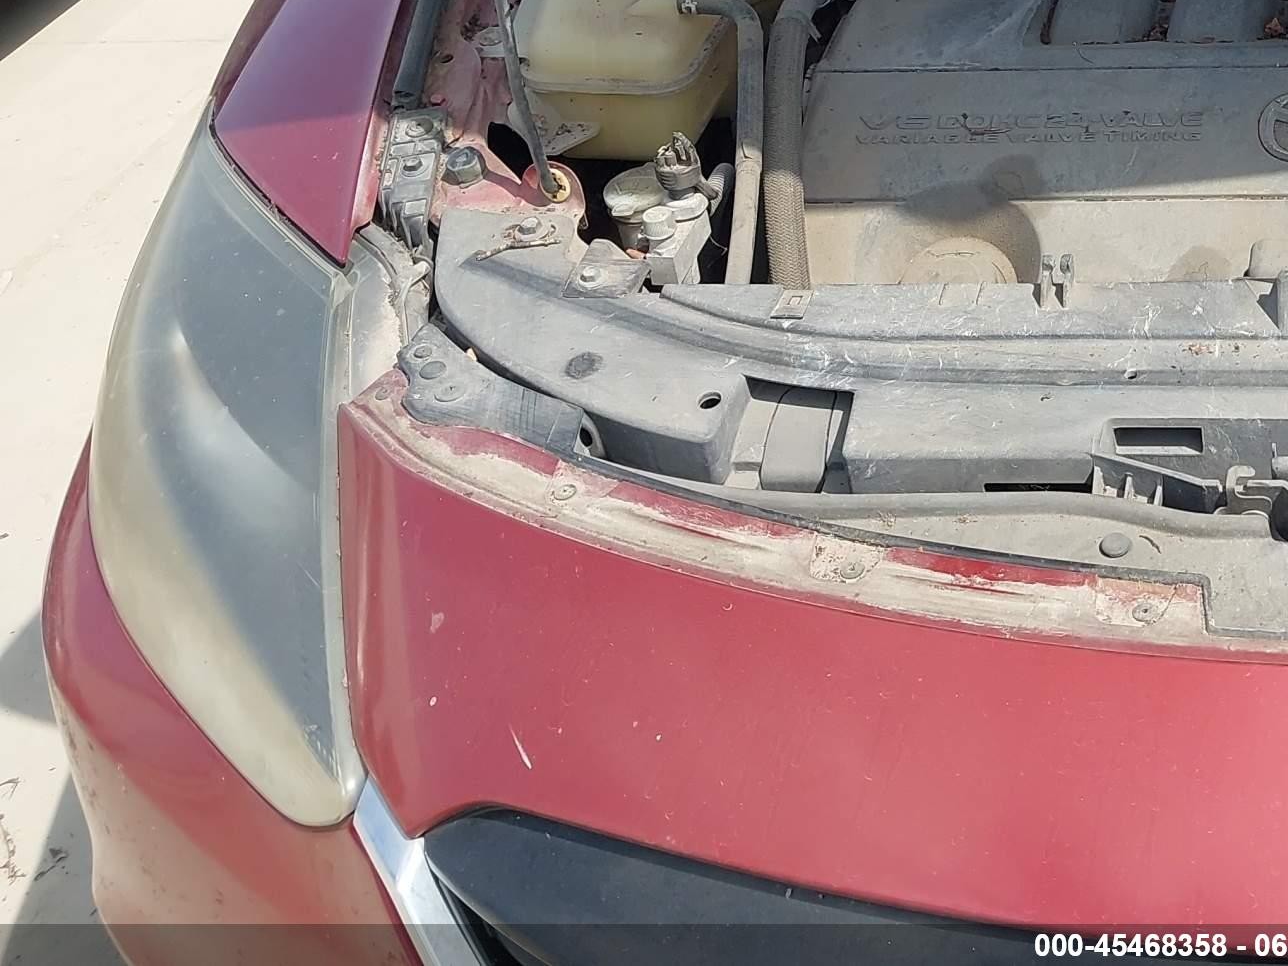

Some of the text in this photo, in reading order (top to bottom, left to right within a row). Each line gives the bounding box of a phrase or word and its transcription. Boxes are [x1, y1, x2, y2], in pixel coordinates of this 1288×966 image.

[859, 114, 931, 130] V6
[855, 131, 1202, 145] VARIABLE VALVE TIMING
